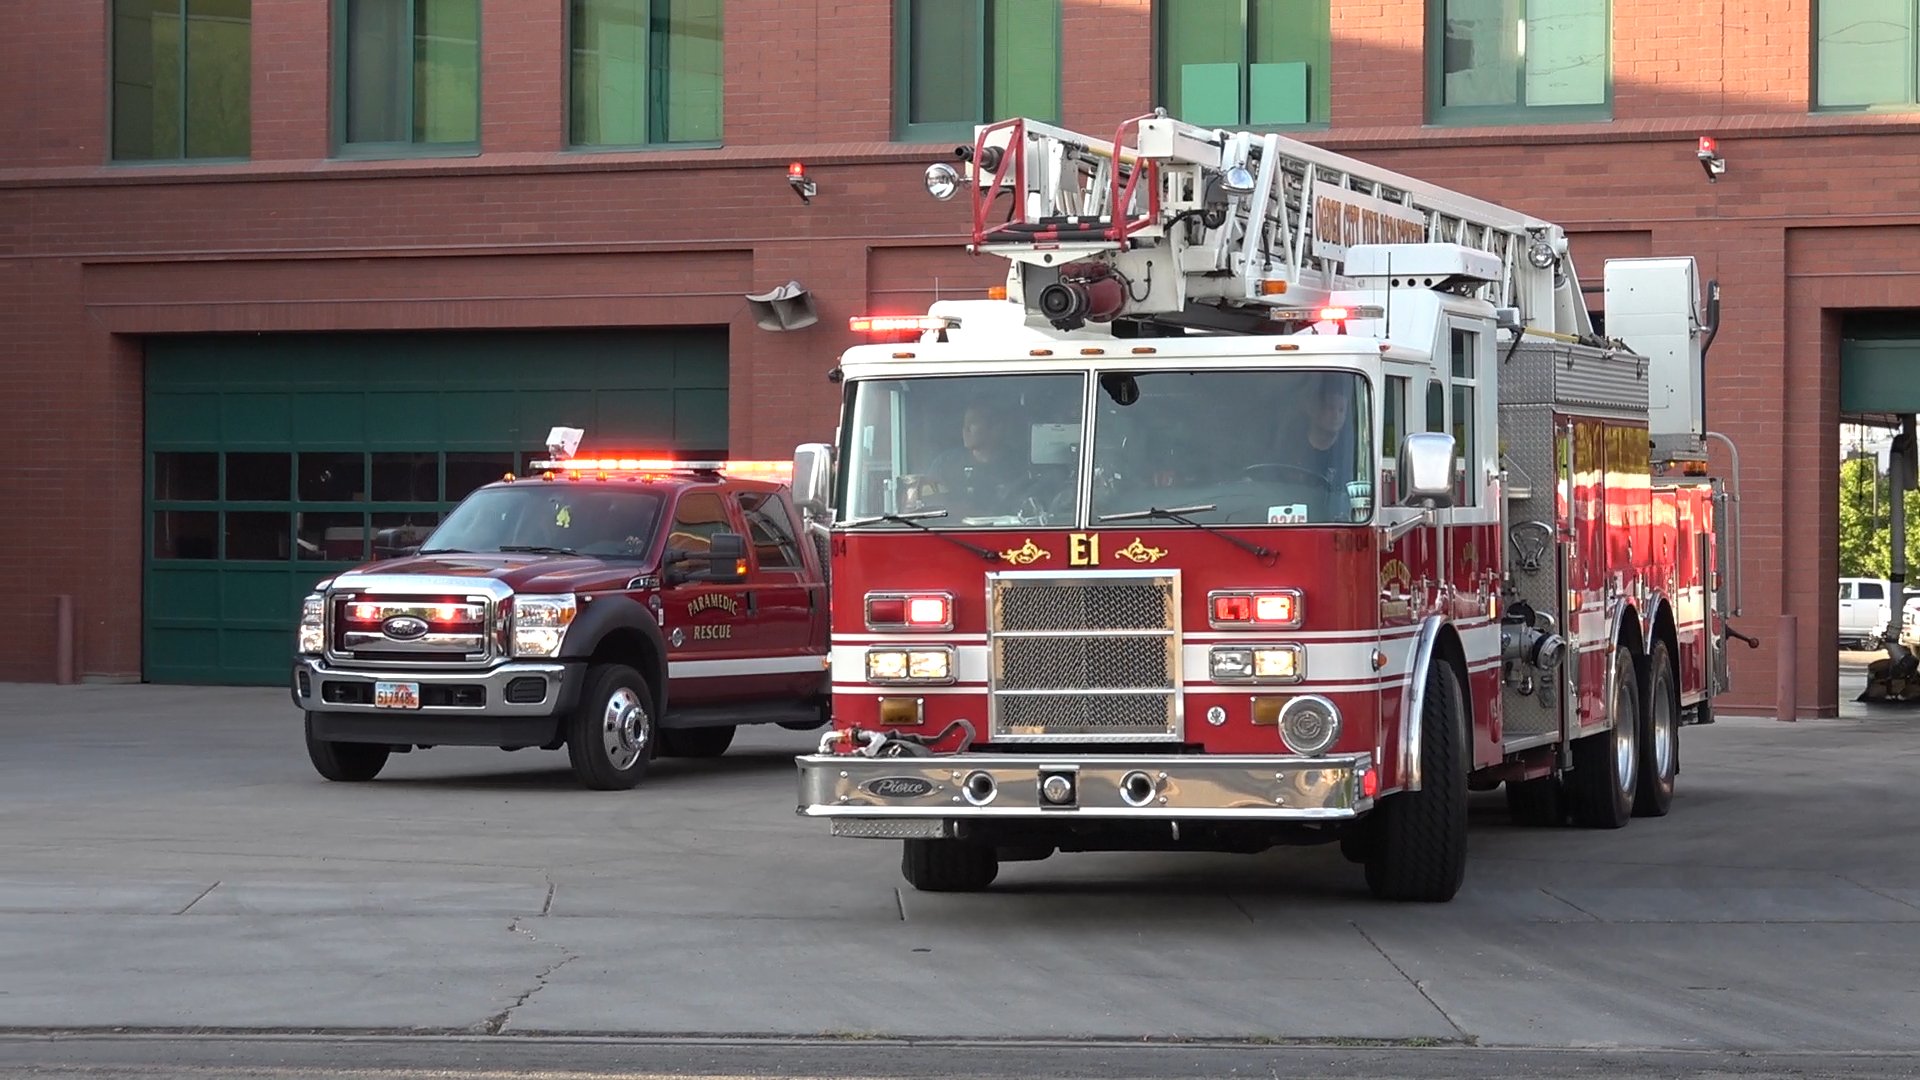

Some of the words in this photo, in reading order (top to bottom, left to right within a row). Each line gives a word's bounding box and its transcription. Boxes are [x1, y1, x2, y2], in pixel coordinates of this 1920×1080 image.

[1068, 532, 1099, 566] E1
[687, 594, 738, 616] PARAMEDIC
[694, 624, 732, 640] RESCUE
[876, 779, 924, 793] Pierce
